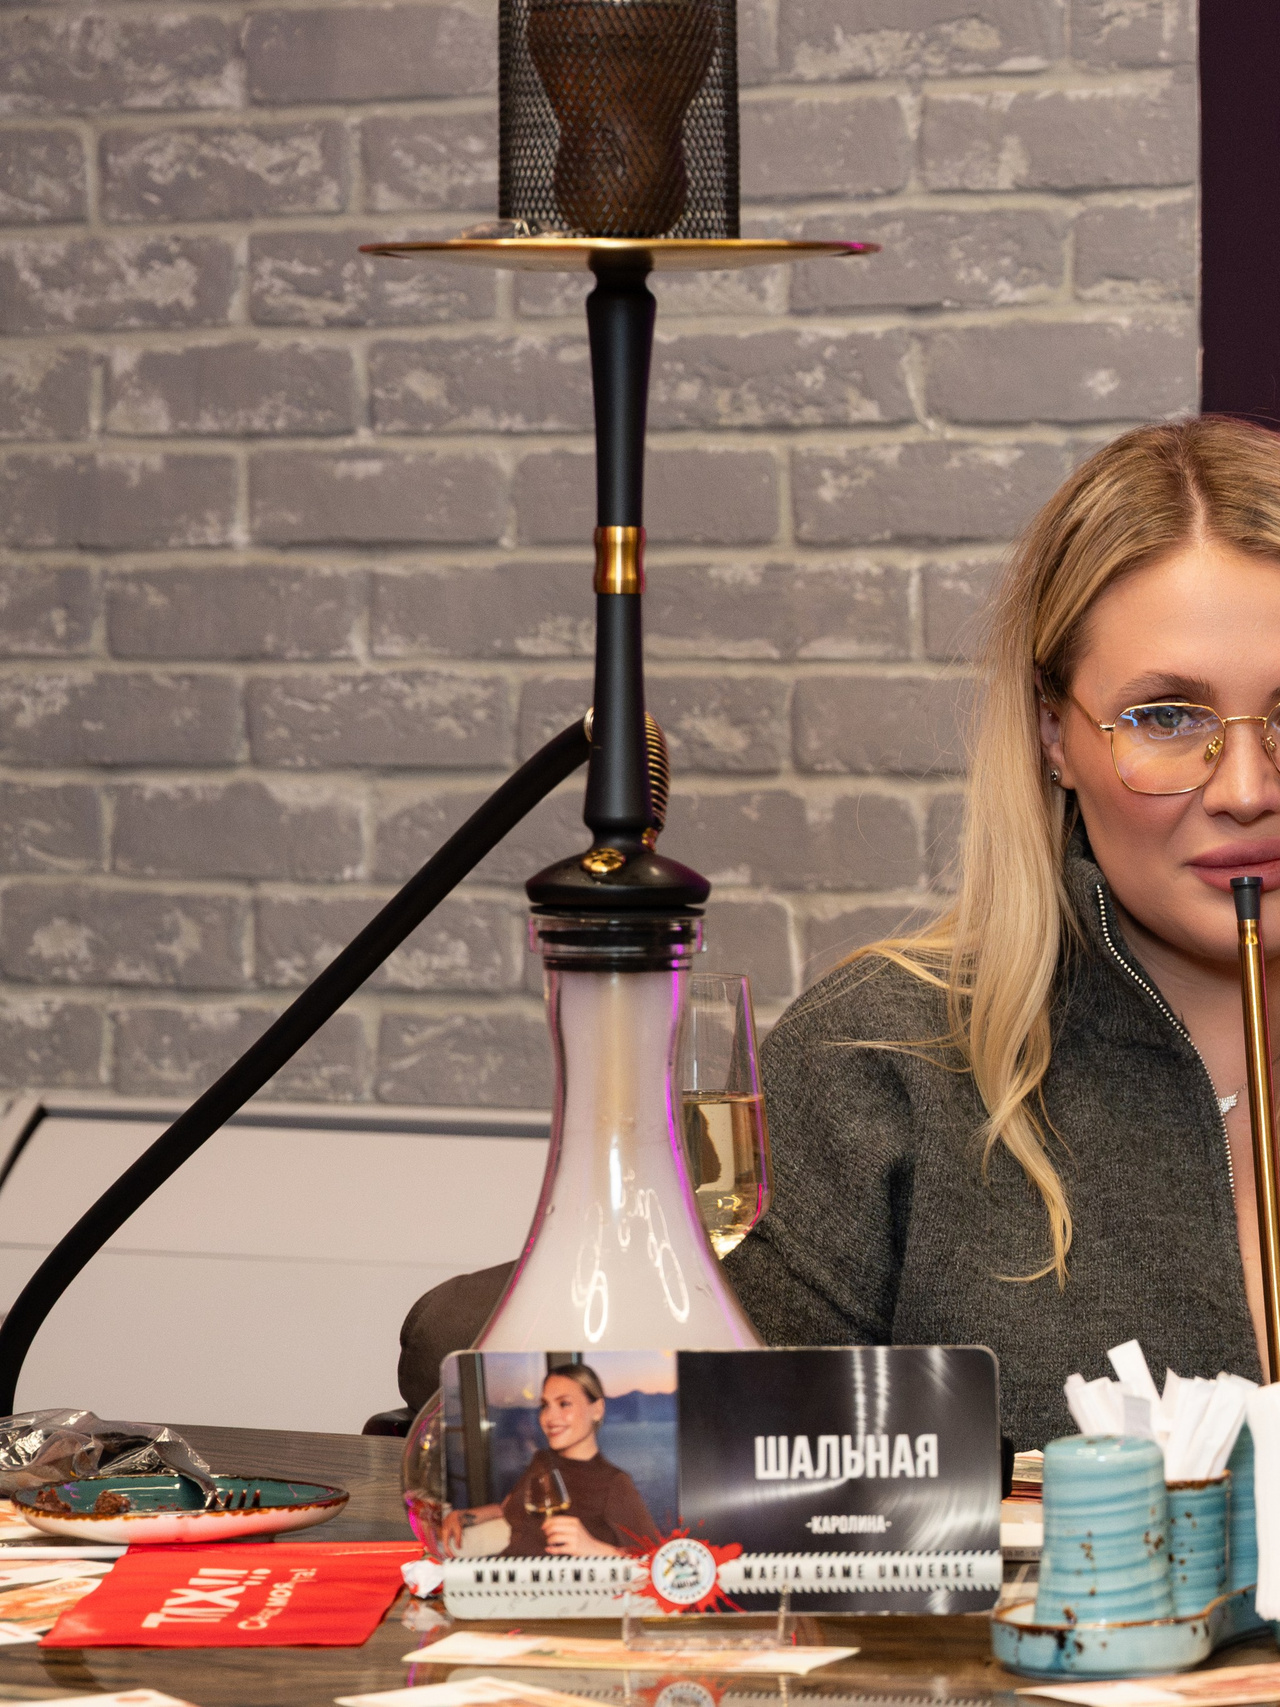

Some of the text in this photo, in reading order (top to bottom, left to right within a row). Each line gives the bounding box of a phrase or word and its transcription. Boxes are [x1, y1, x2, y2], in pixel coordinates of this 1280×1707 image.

[755, 1433, 939, 1480] ШАЛЬНАЯ
[744, 1562, 973, 1579] MAFIA GAME UNIVERSE
